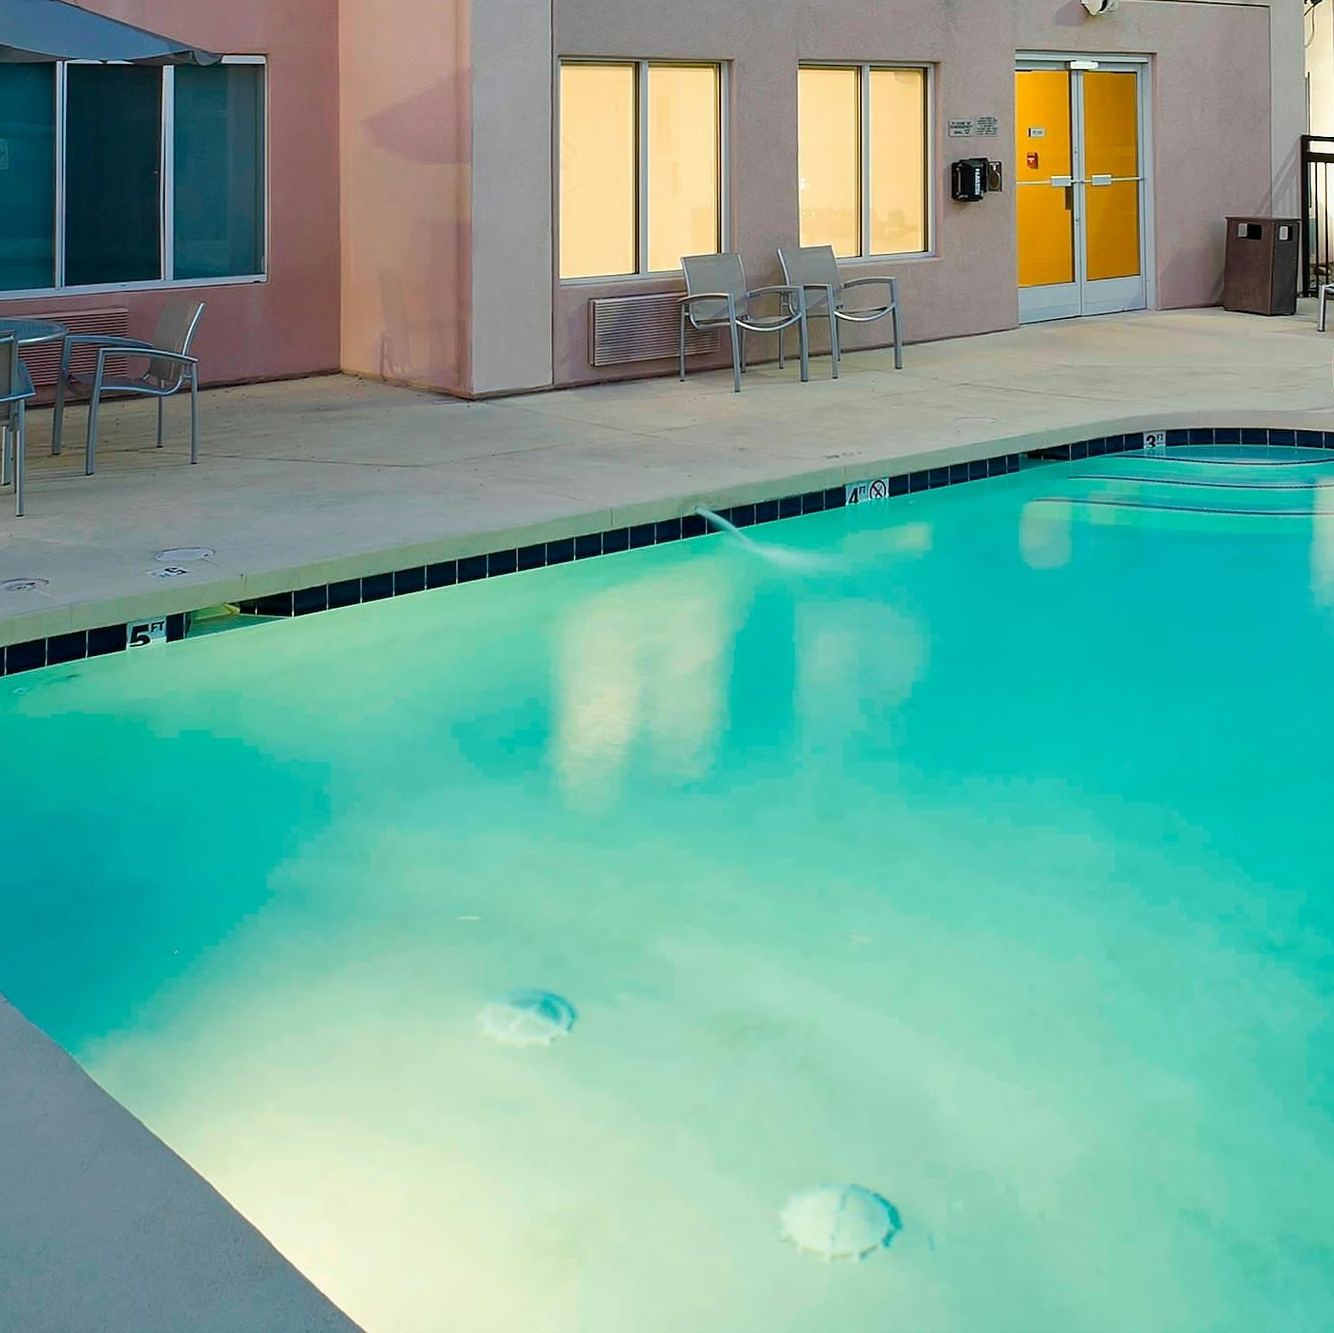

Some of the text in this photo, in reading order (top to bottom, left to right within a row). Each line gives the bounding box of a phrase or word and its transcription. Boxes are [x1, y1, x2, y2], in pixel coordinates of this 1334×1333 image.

[1146, 434, 1156, 447] 3
[848, 487, 859, 504] 4
[130, 621, 165, 647] 5 FT
